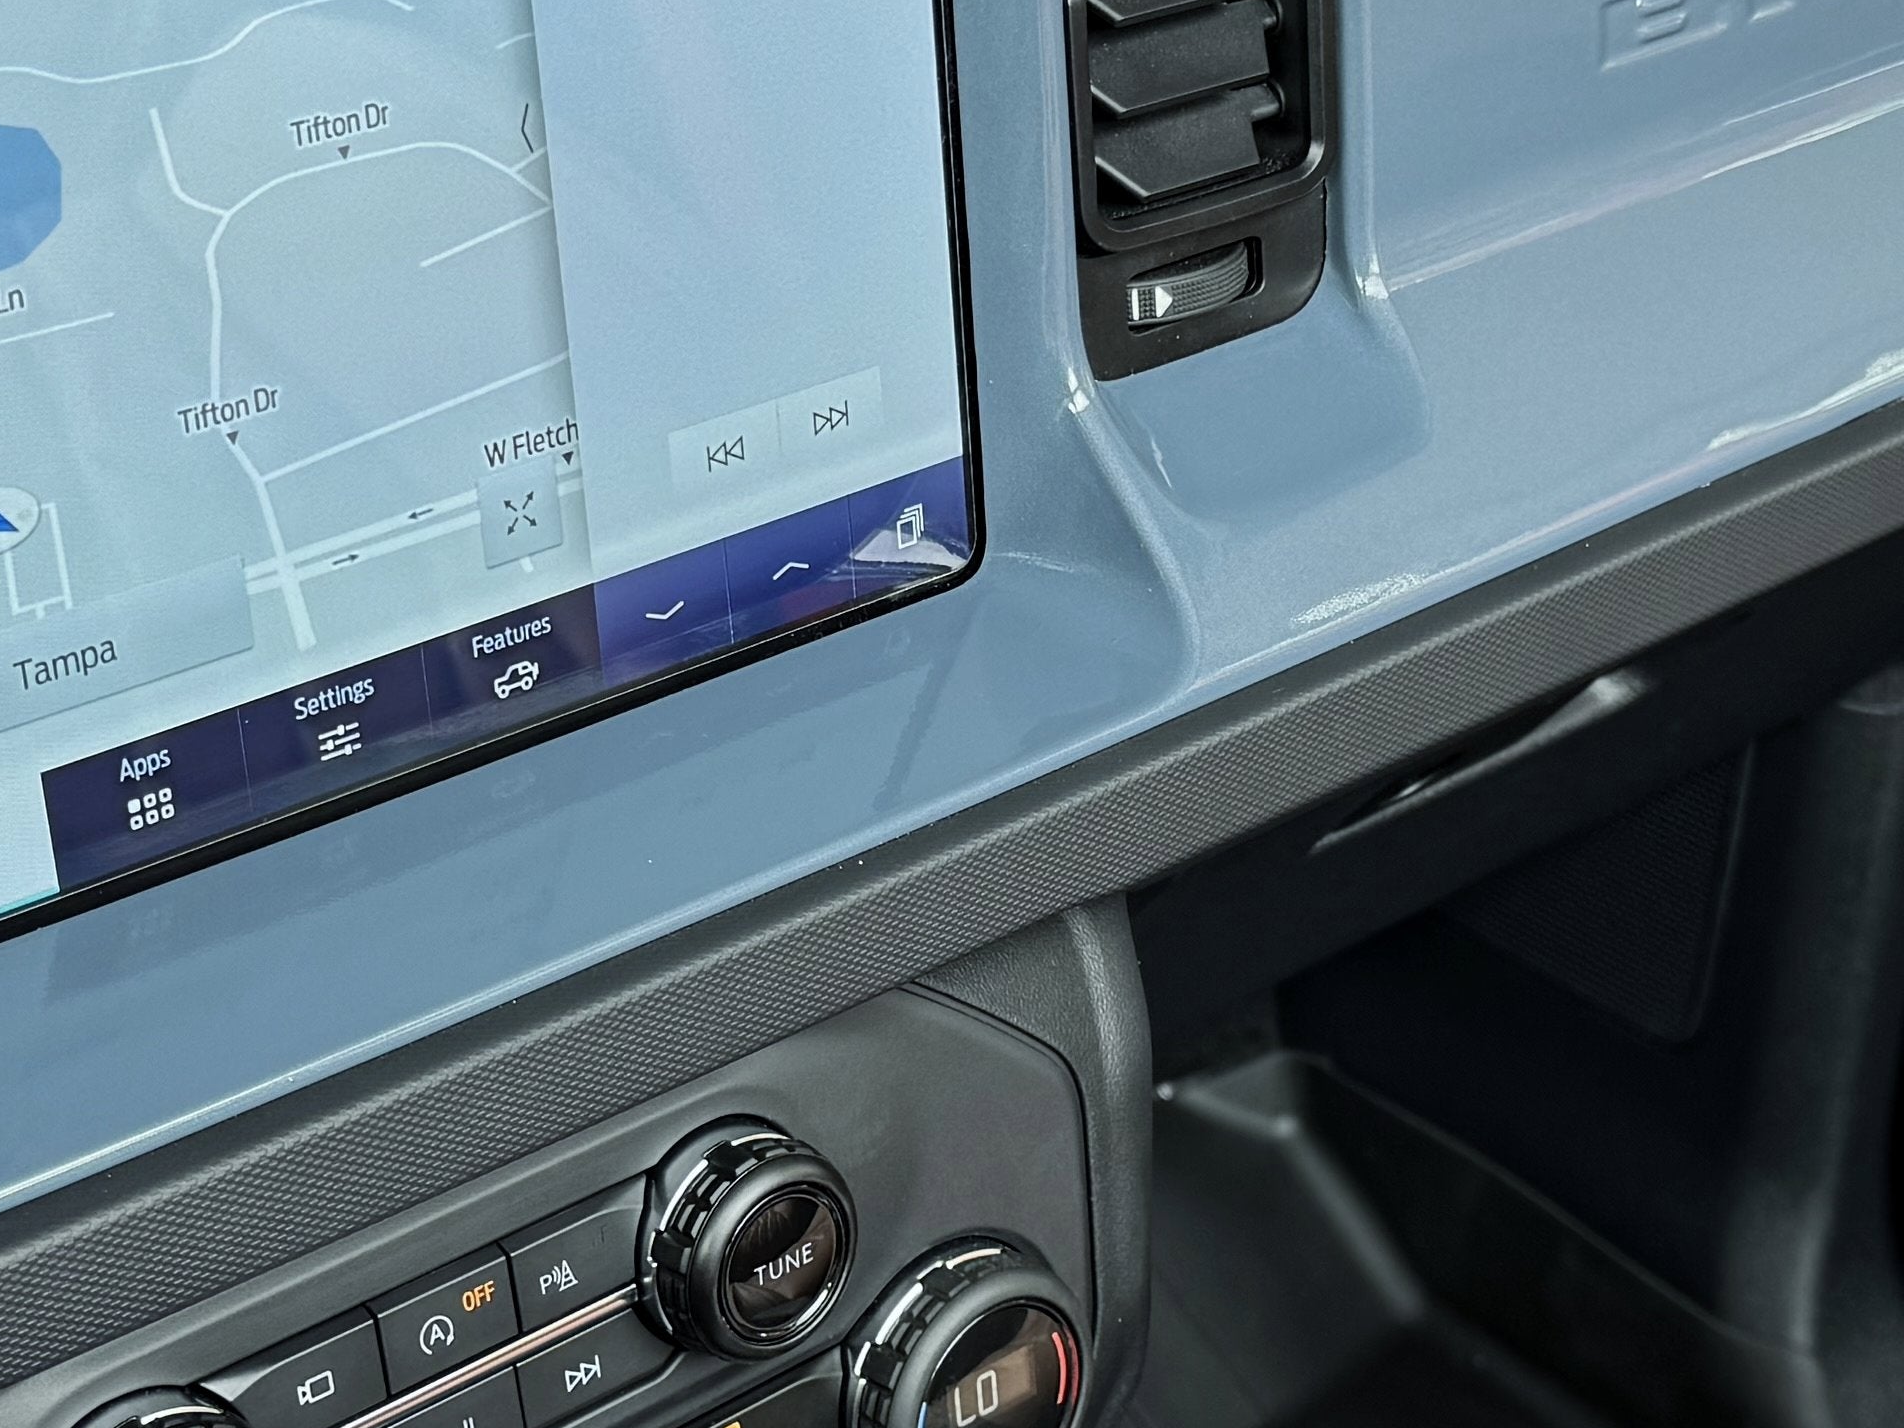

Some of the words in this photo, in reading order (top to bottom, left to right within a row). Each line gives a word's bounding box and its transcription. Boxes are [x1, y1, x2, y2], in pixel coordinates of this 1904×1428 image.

[290, 110, 359, 148] Tifton
[360, 101, 390, 132] Dr
[177, 395, 249, 436] Tifton
[250, 387, 280, 418] Dr
[484, 439, 507, 468] W
[512, 418, 579, 460] Fletch
[471, 613, 552, 659] Features
[13, 635, 118, 693] Tampa
[293, 676, 375, 721] Settings
[118, 746, 172, 782] Apps
[753, 1241, 815, 1287] TUNE
[462, 1280, 496, 1312] OFF
[954, 1369, 998, 1428] LO
